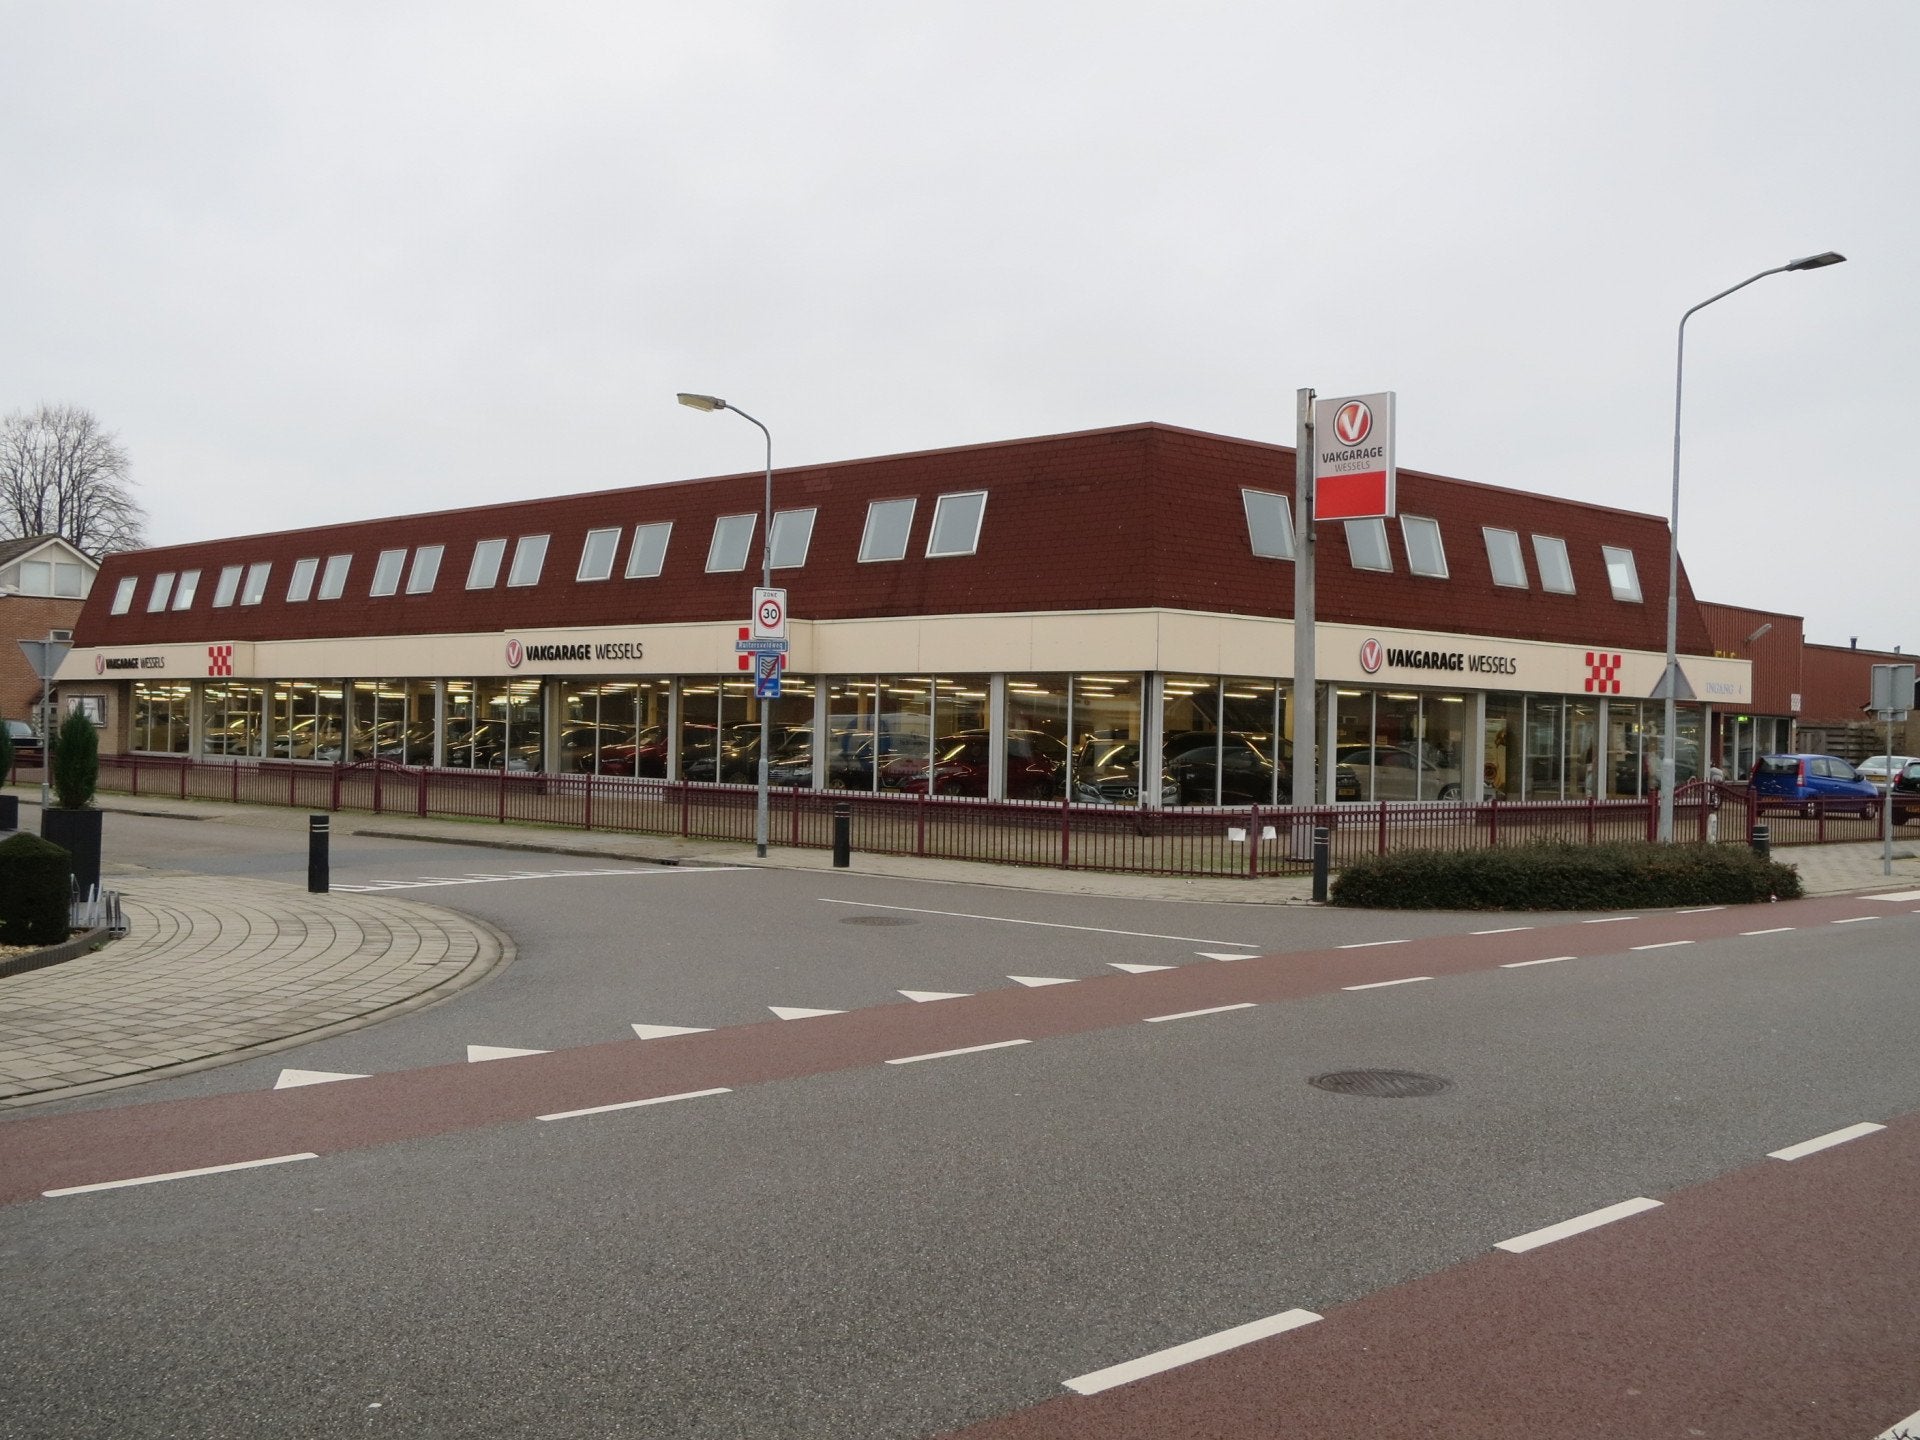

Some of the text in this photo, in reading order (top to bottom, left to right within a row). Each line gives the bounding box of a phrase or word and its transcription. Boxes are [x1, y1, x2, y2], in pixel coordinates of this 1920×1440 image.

[1322, 446, 1383, 463] VAKGARAGE
[1335, 460, 1370, 472] WESSELS
[763, 608, 778, 619] 30
[526, 644, 591, 661] VAKGARAGE
[595, 643, 643, 660] WESSELS
[140, 656, 165, 669] WESSELS
[1386, 649, 1464, 671] VAKGARAGE
[1468, 654, 1517, 675] WESSELS
